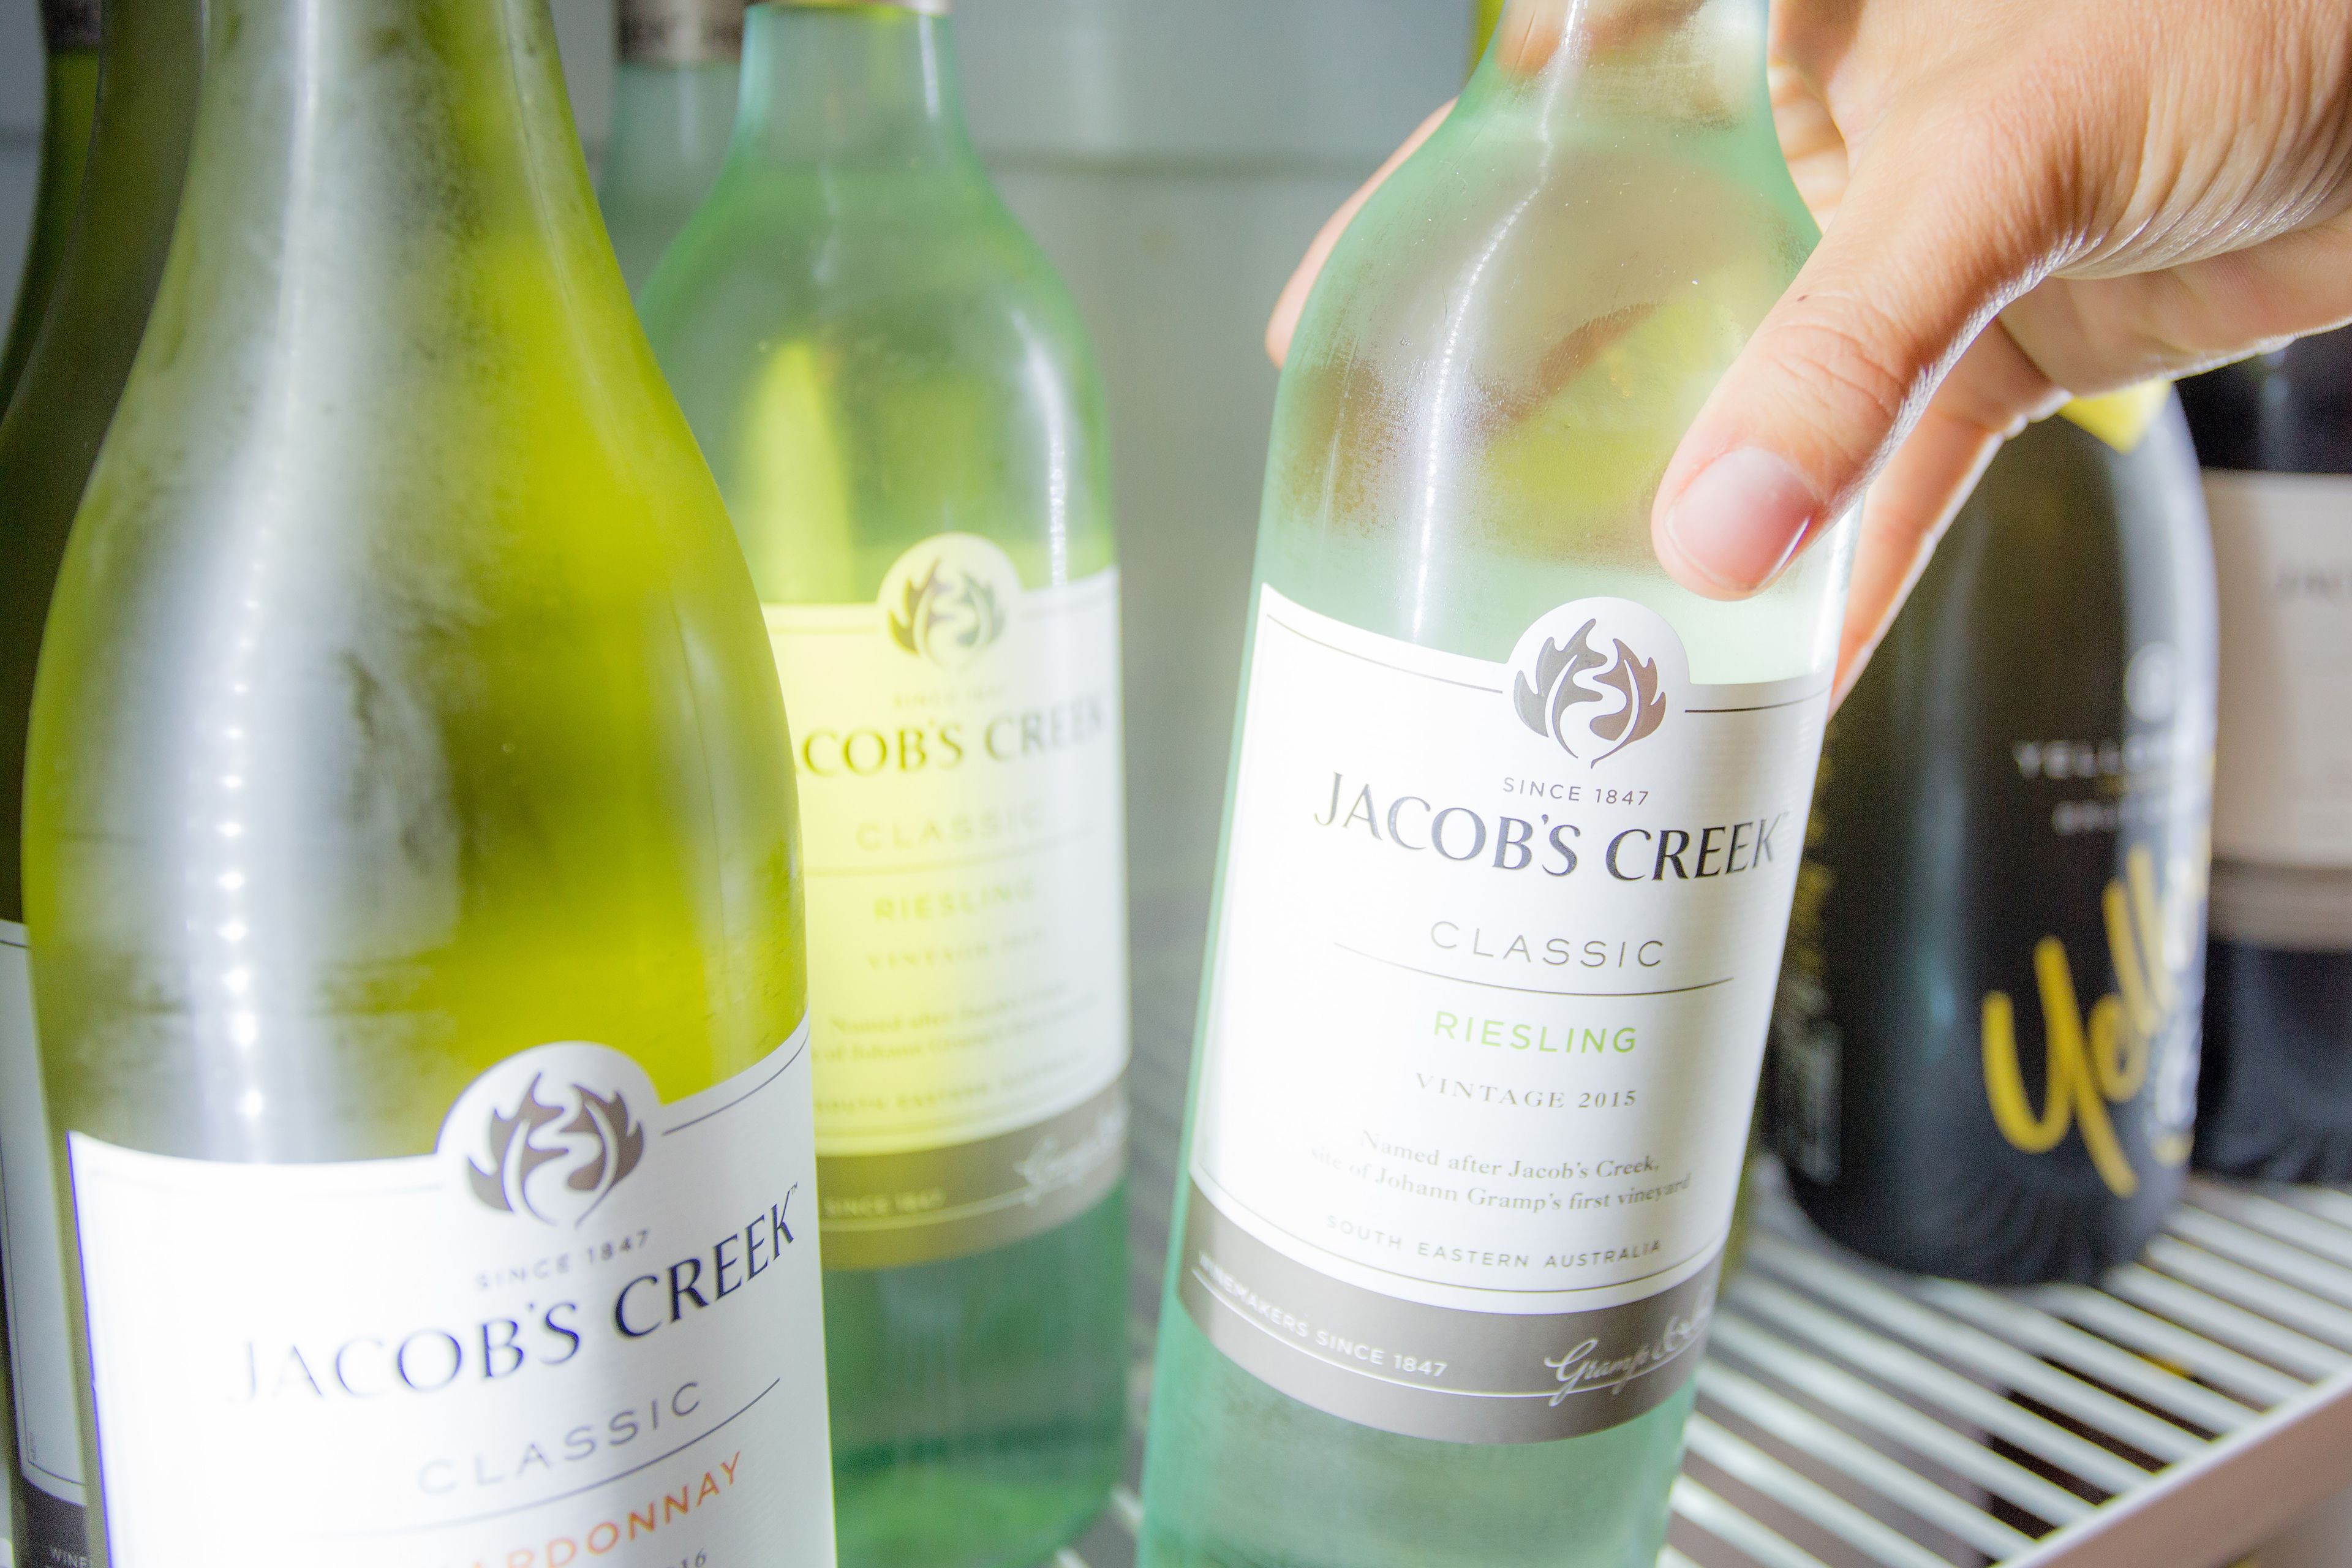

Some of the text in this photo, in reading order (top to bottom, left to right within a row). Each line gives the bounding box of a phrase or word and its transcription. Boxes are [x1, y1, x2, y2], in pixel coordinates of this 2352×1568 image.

[798, 719, 964, 777] COB'S
[1502, 777, 1650, 806] SINCE 1847
[1313, 771, 1783, 882] JACOB'S CREEK
[1430, 920, 1664, 968] CLASSIC
[1433, 1010, 1636, 1054] RIESLING
[1415, 1072, 1637, 1109] VINTAGE 2015
[1360, 1129, 1660, 1180] Named after Jacob's Creek,
[1349, 1162, 1372, 1180] of
[1374, 1167, 1458, 1202] Johann
[1467, 1187, 1562, 1214] Gramp's
[1568, 1192, 1610, 1211] first
[1617, 1172, 1692, 1206] vineyard
[476, 1227, 649, 1292] SINCE 1847
[1326, 1214, 1660, 1268] SOUTH EASTERN AUSTRALIA
[224, 1300, 579, 1405] JACOB'S
[614, 1188, 795, 1340] CREEK
[1199, 1250, 1449, 1378] WINEMAKERS SINCE 1847
[417, 1381, 699, 1495] CLASSIC
[469, 1450, 740, 1568] RDONNAY
[48, 1545, 93, 1568] WINE
